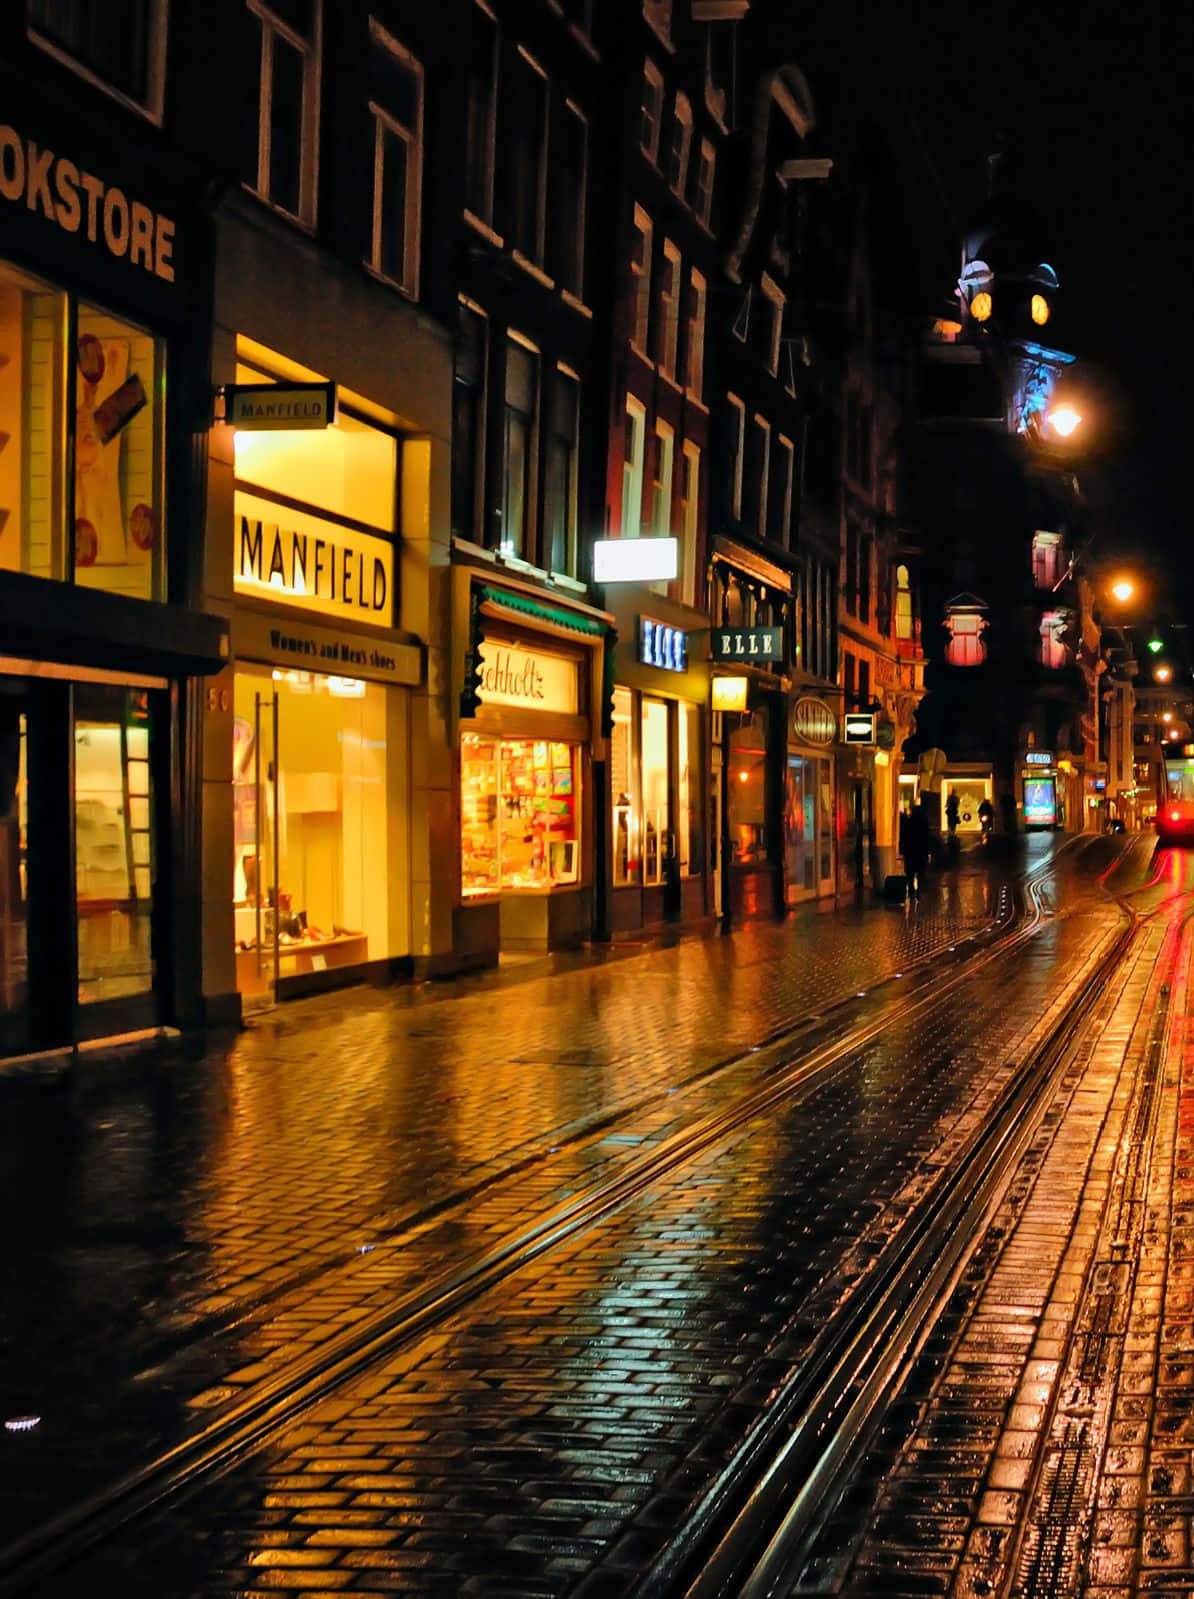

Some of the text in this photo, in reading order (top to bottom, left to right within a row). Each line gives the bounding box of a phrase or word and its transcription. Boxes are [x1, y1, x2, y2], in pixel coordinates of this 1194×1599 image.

[0, 124, 175, 282] OKSTORE
[241, 401, 322, 417] MANFIELD
[241, 516, 386, 611] MANFIELD
[320, 641, 338, 660] and
[721, 634, 772, 655] ELLE
